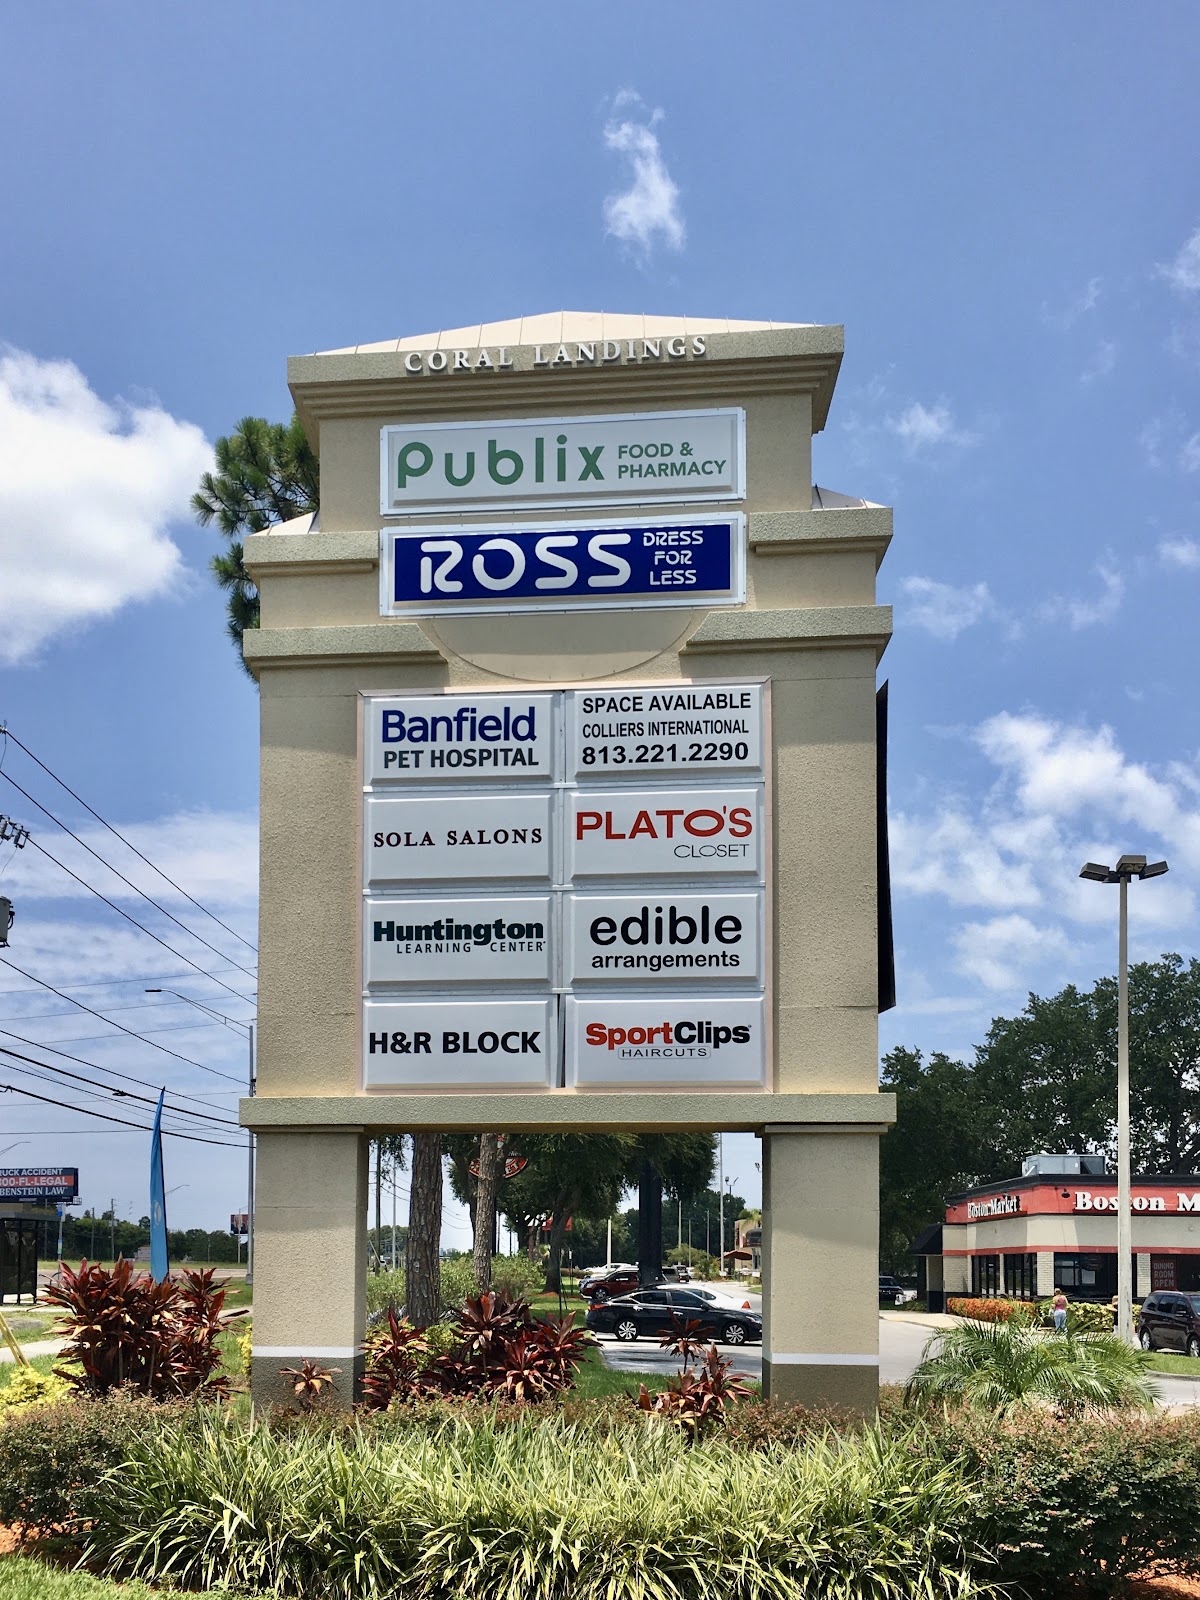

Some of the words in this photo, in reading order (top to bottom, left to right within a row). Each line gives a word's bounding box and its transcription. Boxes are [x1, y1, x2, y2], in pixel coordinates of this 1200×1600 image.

[404, 346, 513, 373] CORAL
[534, 336, 707, 367] LANDINGS
[618, 443, 674, 460] FOOD
[679, 441, 694, 457] &
[397, 434, 605, 489] Publix
[618, 459, 727, 479] PHARMACY
[643, 530, 704, 547] DRESS
[420, 533, 632, 593] ROSS
[654, 550, 692, 566] FOR
[649, 570, 697, 586] LESS
[582, 696, 644, 714] SPACE
[648, 692, 752, 712] AVAILABLE
[381, 706, 537, 743] Banfield
[582, 722, 645, 739] COLLIERS
[648, 719, 749, 736] INTERNATIONAL
[383, 749, 424, 769] PET
[430, 748, 539, 768] HOSPITAL
[582, 742, 749, 765] 813.221.2290
[576, 805, 753, 841] PLATO'S
[373, 831, 436, 848] SOLA
[446, 828, 543, 846] SALONS
[673, 843, 750, 859] CLOSET
[373, 918, 544, 946] Huntington
[589, 905, 743, 946] edible
[396, 942, 472, 954] LEARNING
[490, 941, 544, 953] CENTER
[591, 950, 740, 972] arrangements
[369, 1032, 431, 1054] H&R
[442, 1031, 541, 1054] BLOCK
[621, 1048, 707, 1058] HAIRCUTS
[0, 1176, 68, 1186] 00-FL-LEGAL
[45, 1187, 65, 1195] LAW
[967, 1201, 989, 1219] Boston
[990, 1196, 1017, 1215] Market
[1074, 1191, 1166, 1211] Boson
[1153, 1262, 1174, 1270] DINING
[1154, 1270, 1174, 1279] ROOM
[1154, 1279, 1174, 1288] OPEN
